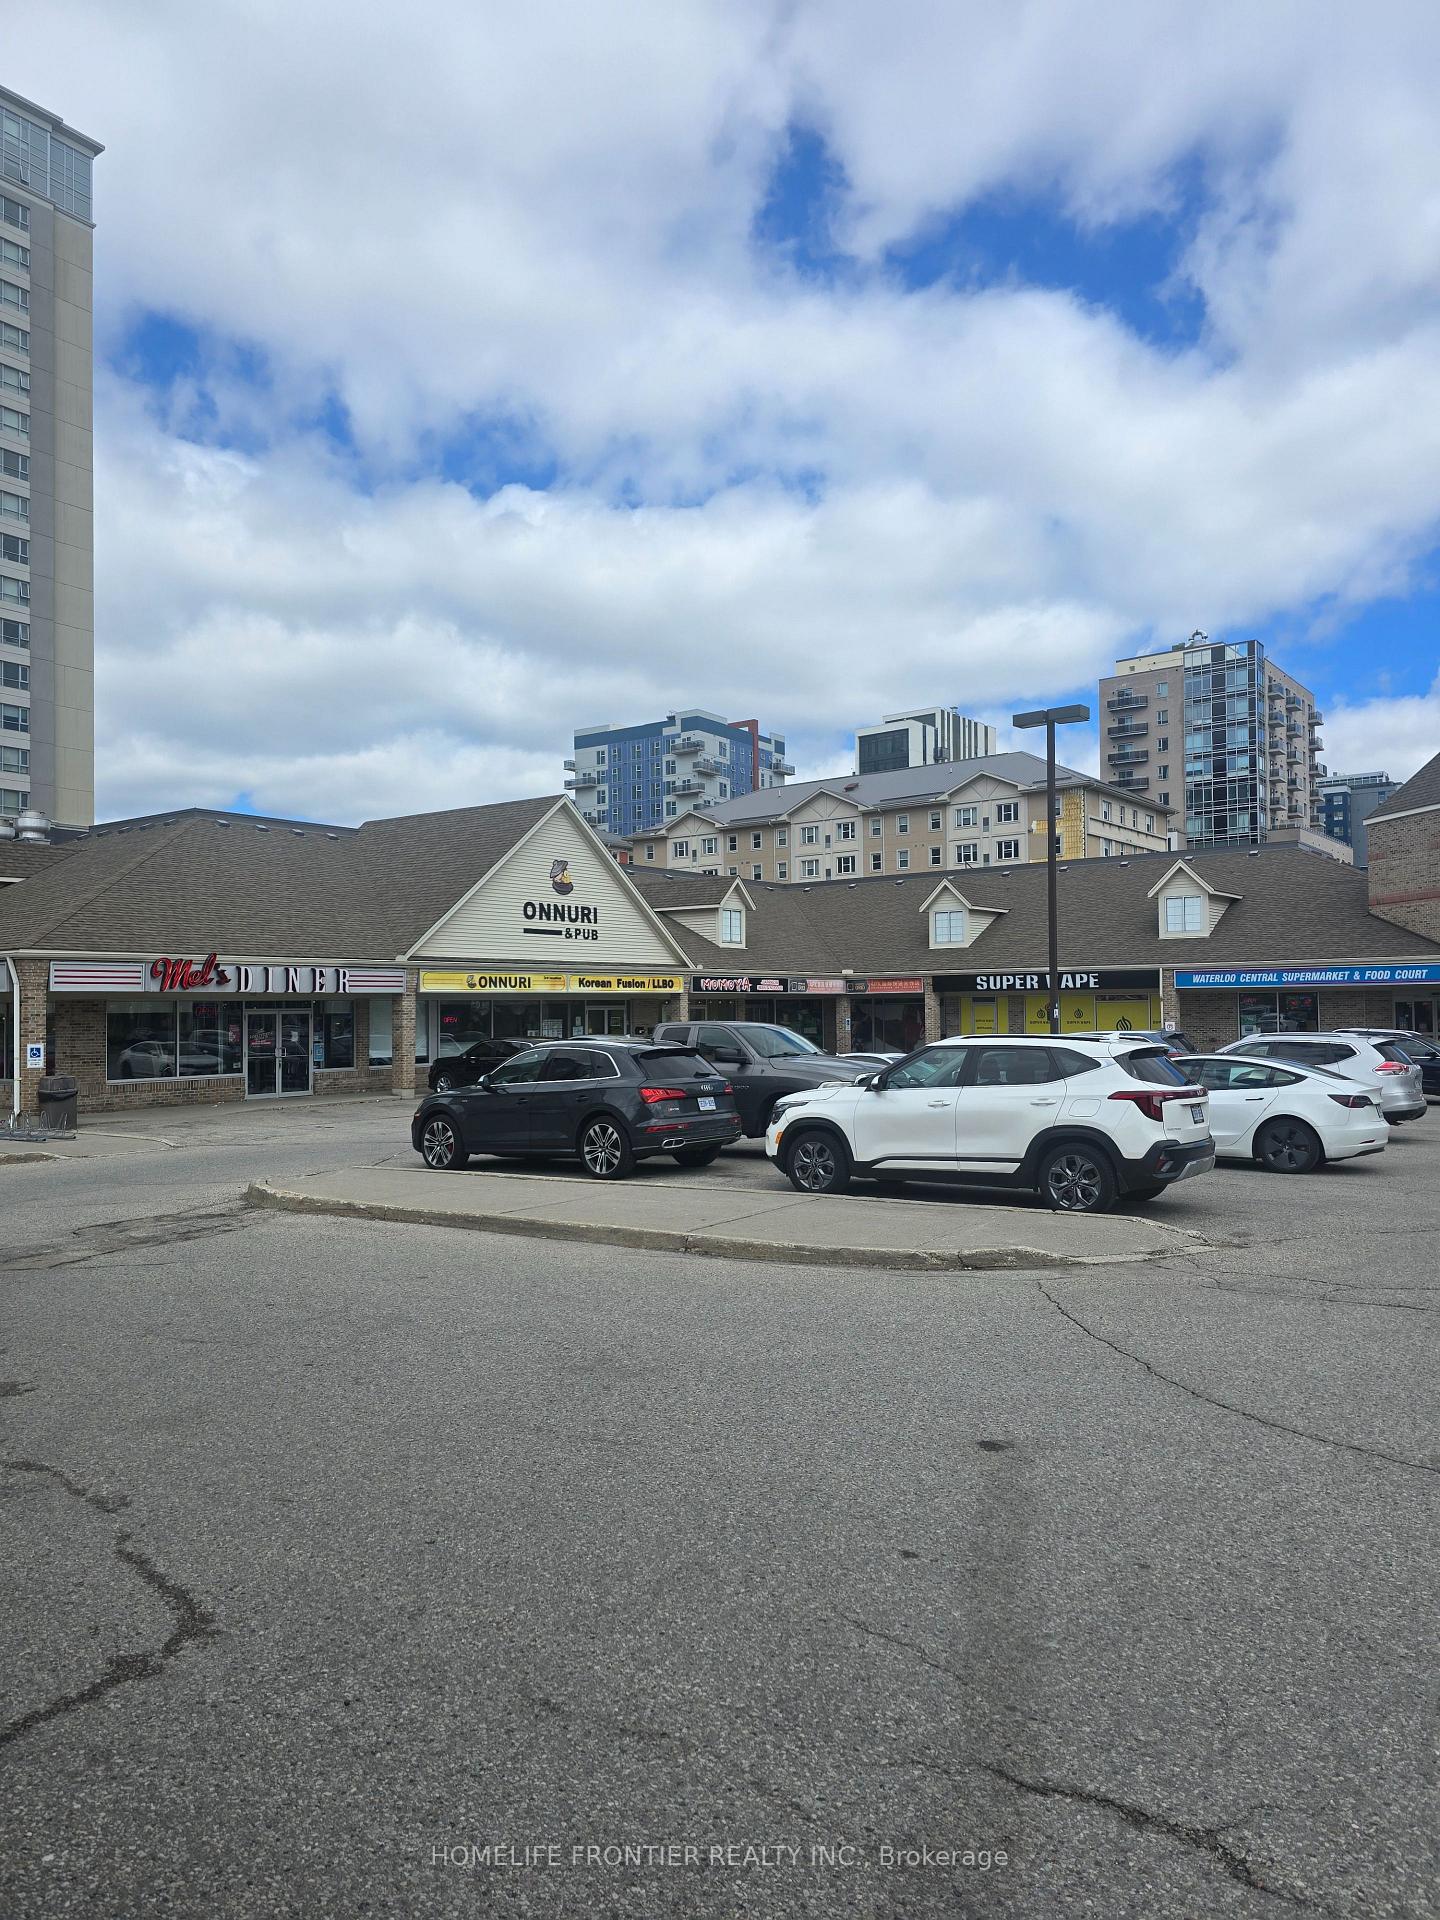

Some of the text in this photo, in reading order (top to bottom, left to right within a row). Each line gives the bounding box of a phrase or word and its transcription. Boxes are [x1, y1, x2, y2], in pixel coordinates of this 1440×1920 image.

[523, 901, 598, 924] ONNURI
[564, 927, 599, 941] &PUB
[151, 953, 351, 993] Mel's DINER
[1192, 969, 1429, 983] WATERLOO CENTRAL SUPERMARKET & FOOD COURT
[478, 976, 532, 989] ONNURI
[578, 977, 612, 988] Korean
[616, 978, 646, 989] Fusion
[652, 979, 674, 989] LLBO
[700, 977, 751, 992] MOMOYA
[976, 974, 1038, 990] SUPER
